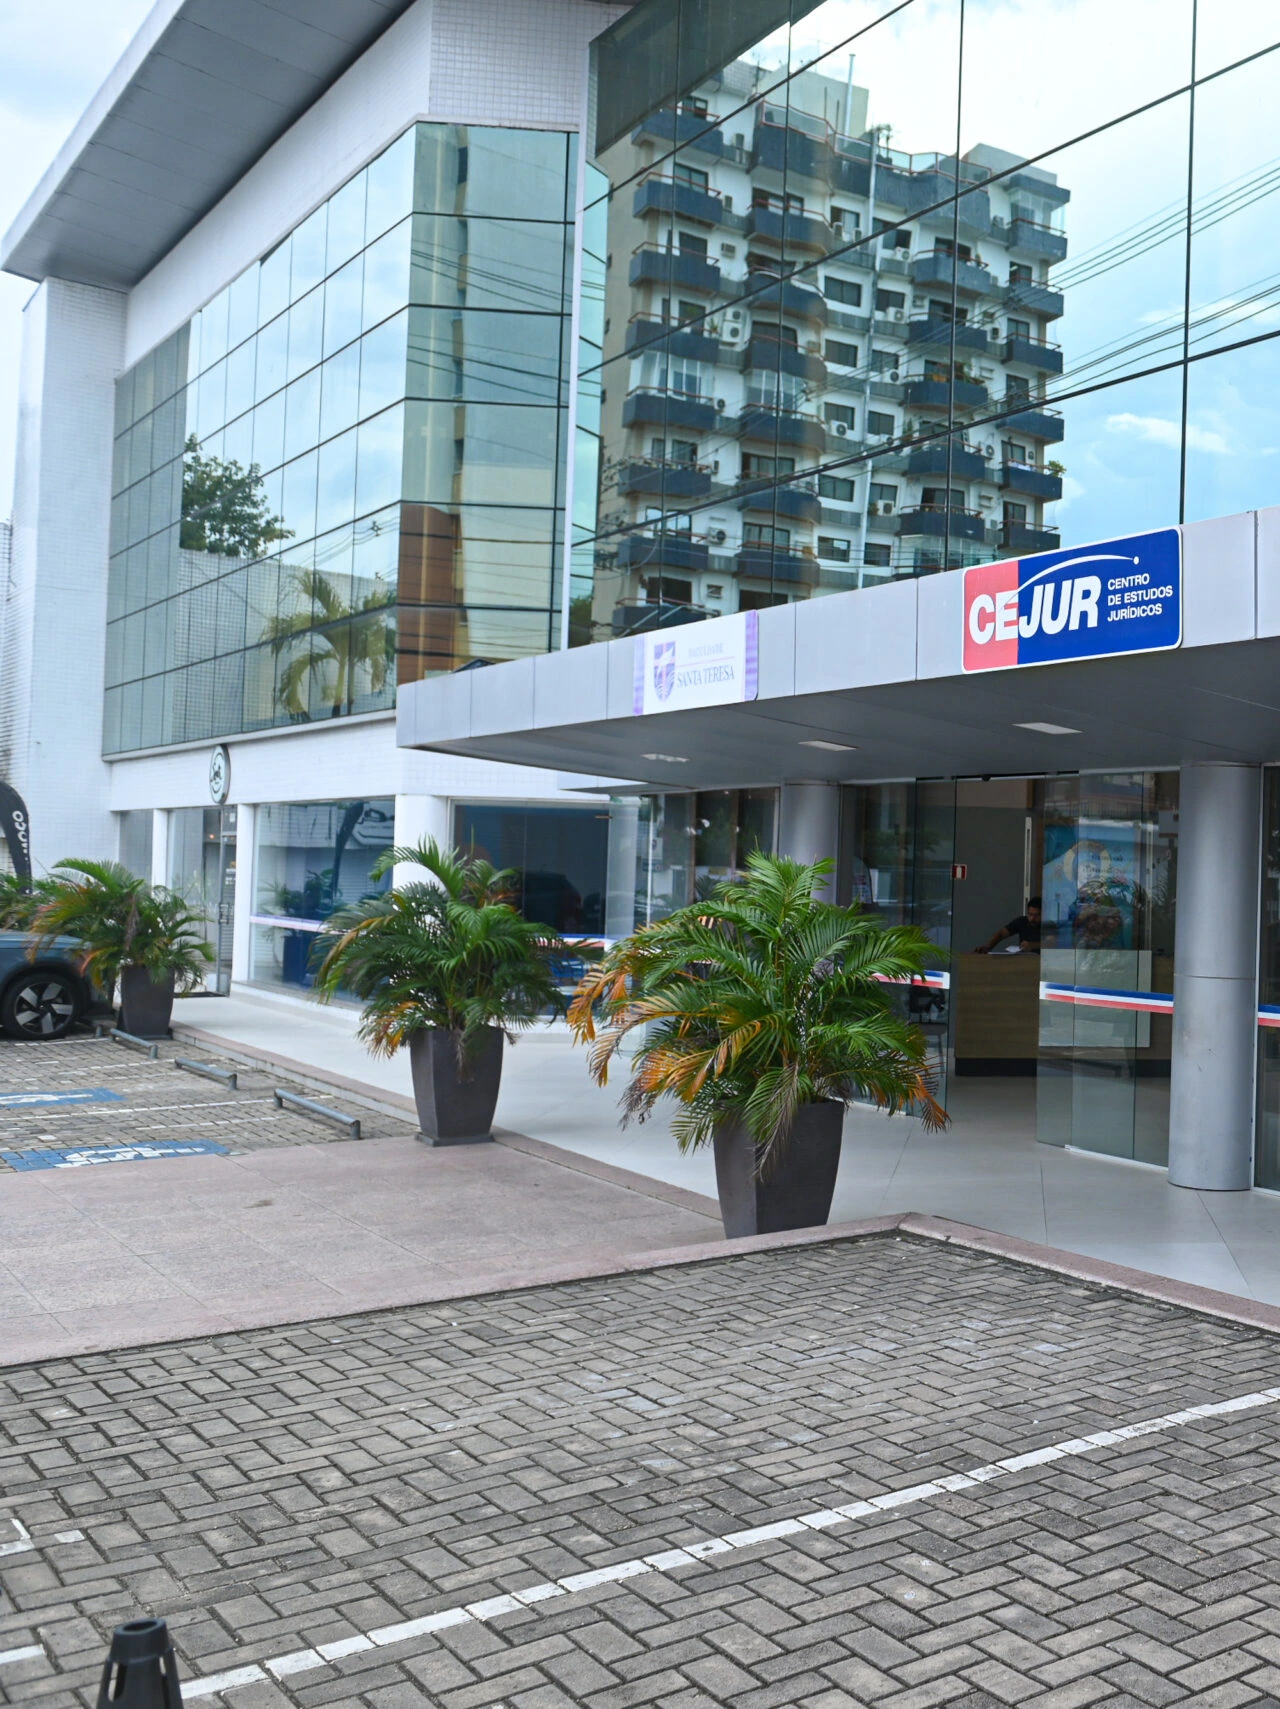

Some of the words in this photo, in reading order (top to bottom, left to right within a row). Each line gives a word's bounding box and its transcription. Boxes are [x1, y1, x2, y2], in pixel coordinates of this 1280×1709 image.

[1107, 573, 1150, 591] CENTRO
[1107, 594, 1122, 606] DE
[1124, 585, 1174, 604] ESTUDOS
[968, 575, 1102, 645] CEJUR
[1107, 603, 1163, 622] JURÍDICOS
[676, 669, 702, 688] SANTA
[703, 664, 735, 684] TERESA
